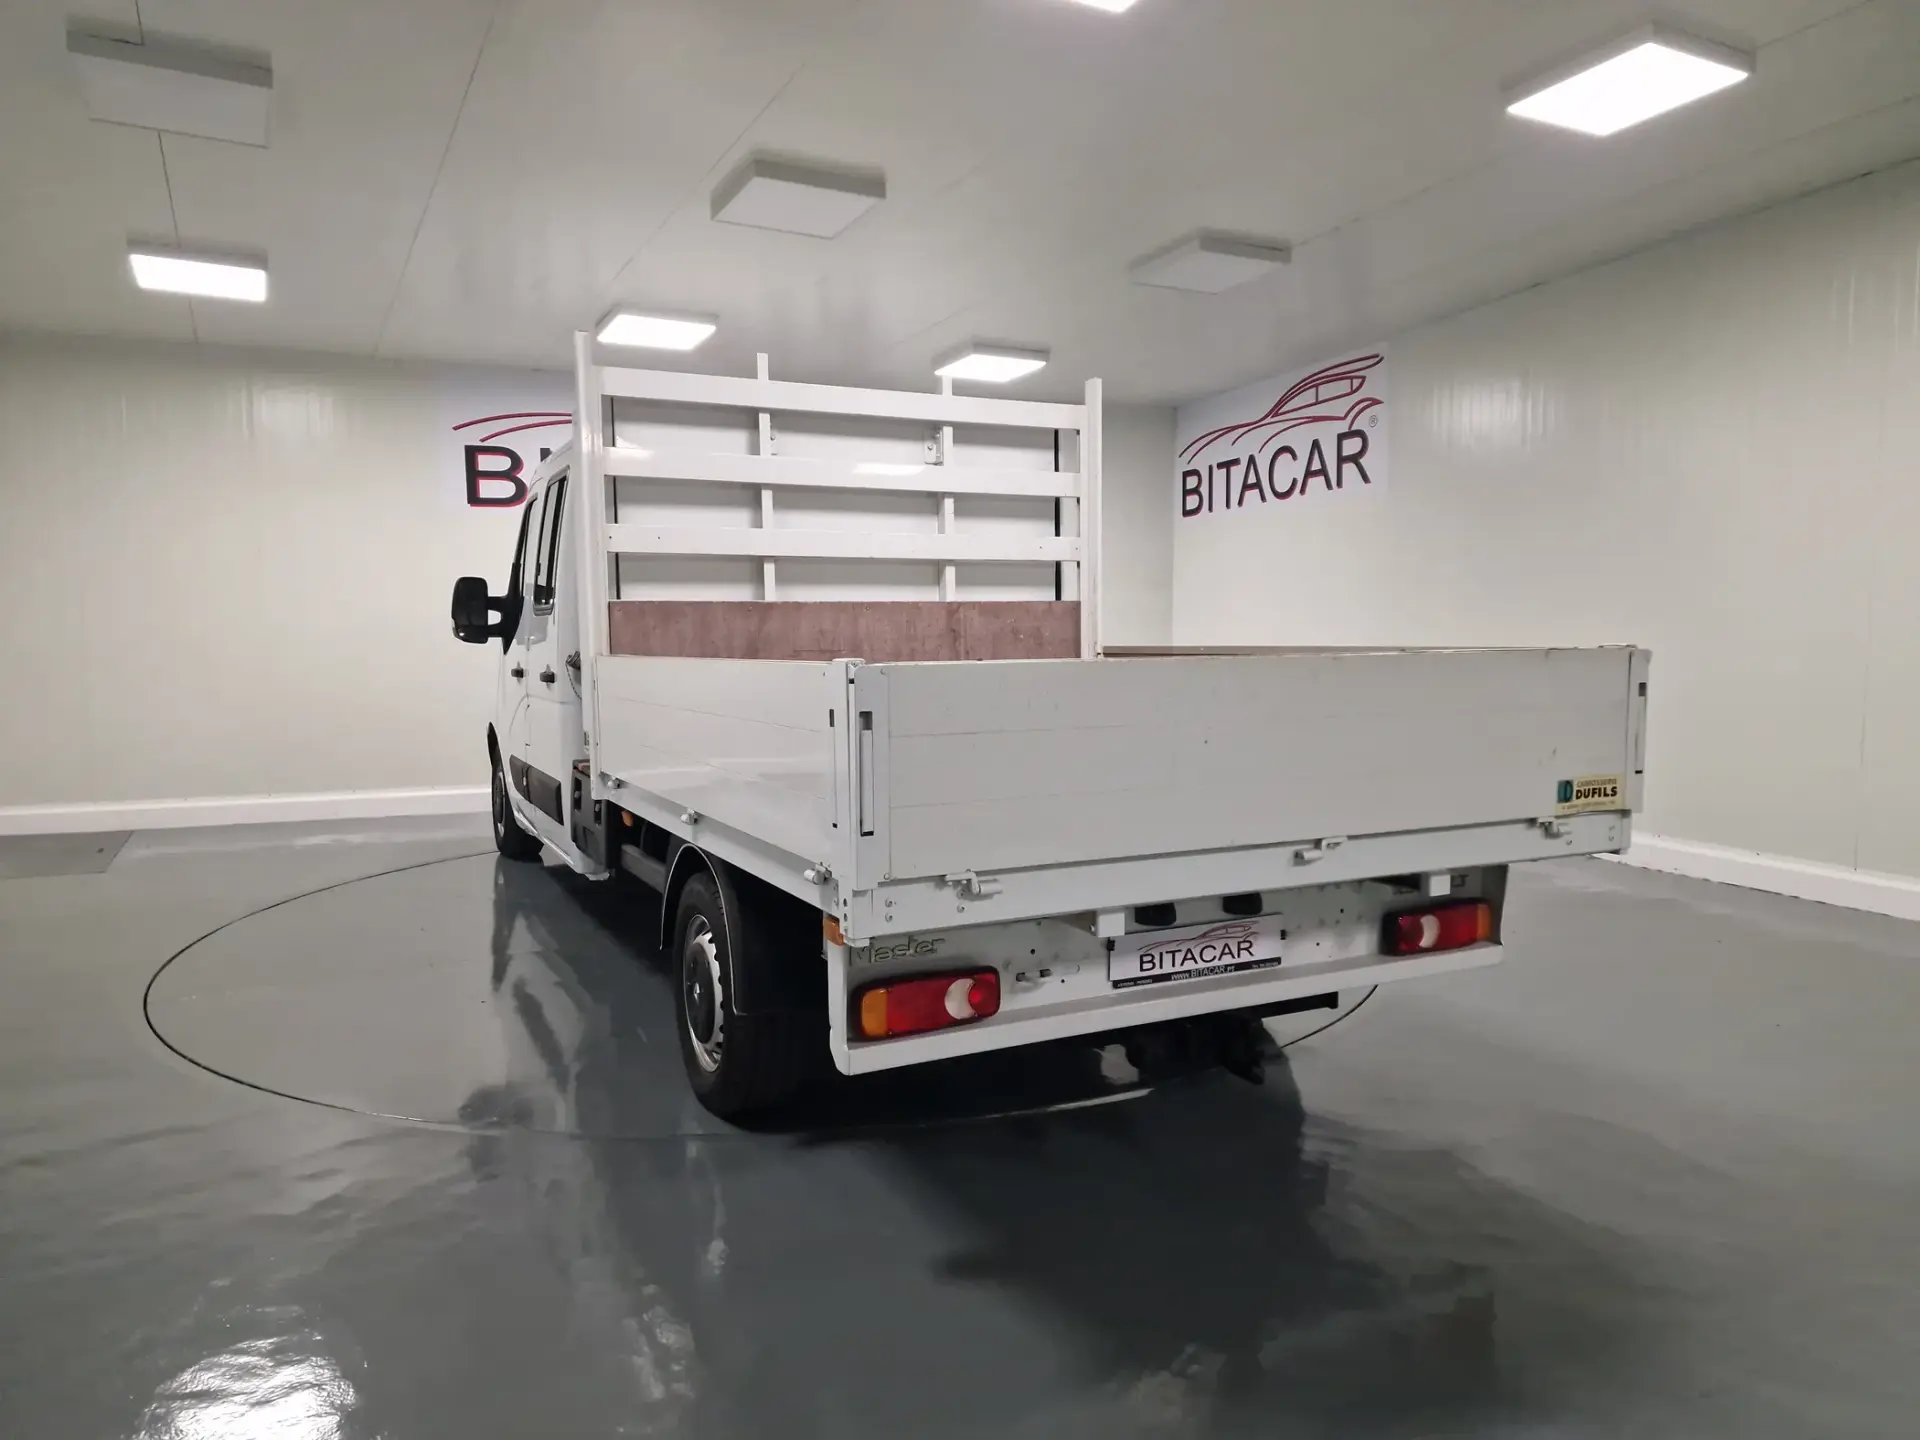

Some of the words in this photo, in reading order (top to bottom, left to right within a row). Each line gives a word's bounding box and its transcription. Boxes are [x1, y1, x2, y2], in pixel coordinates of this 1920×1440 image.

[463, 444, 553, 508] B
[1181, 428, 1372, 518] BITACAR
[1575, 786, 1618, 800] DUFILS
[1139, 939, 1255, 973] BITACAR
